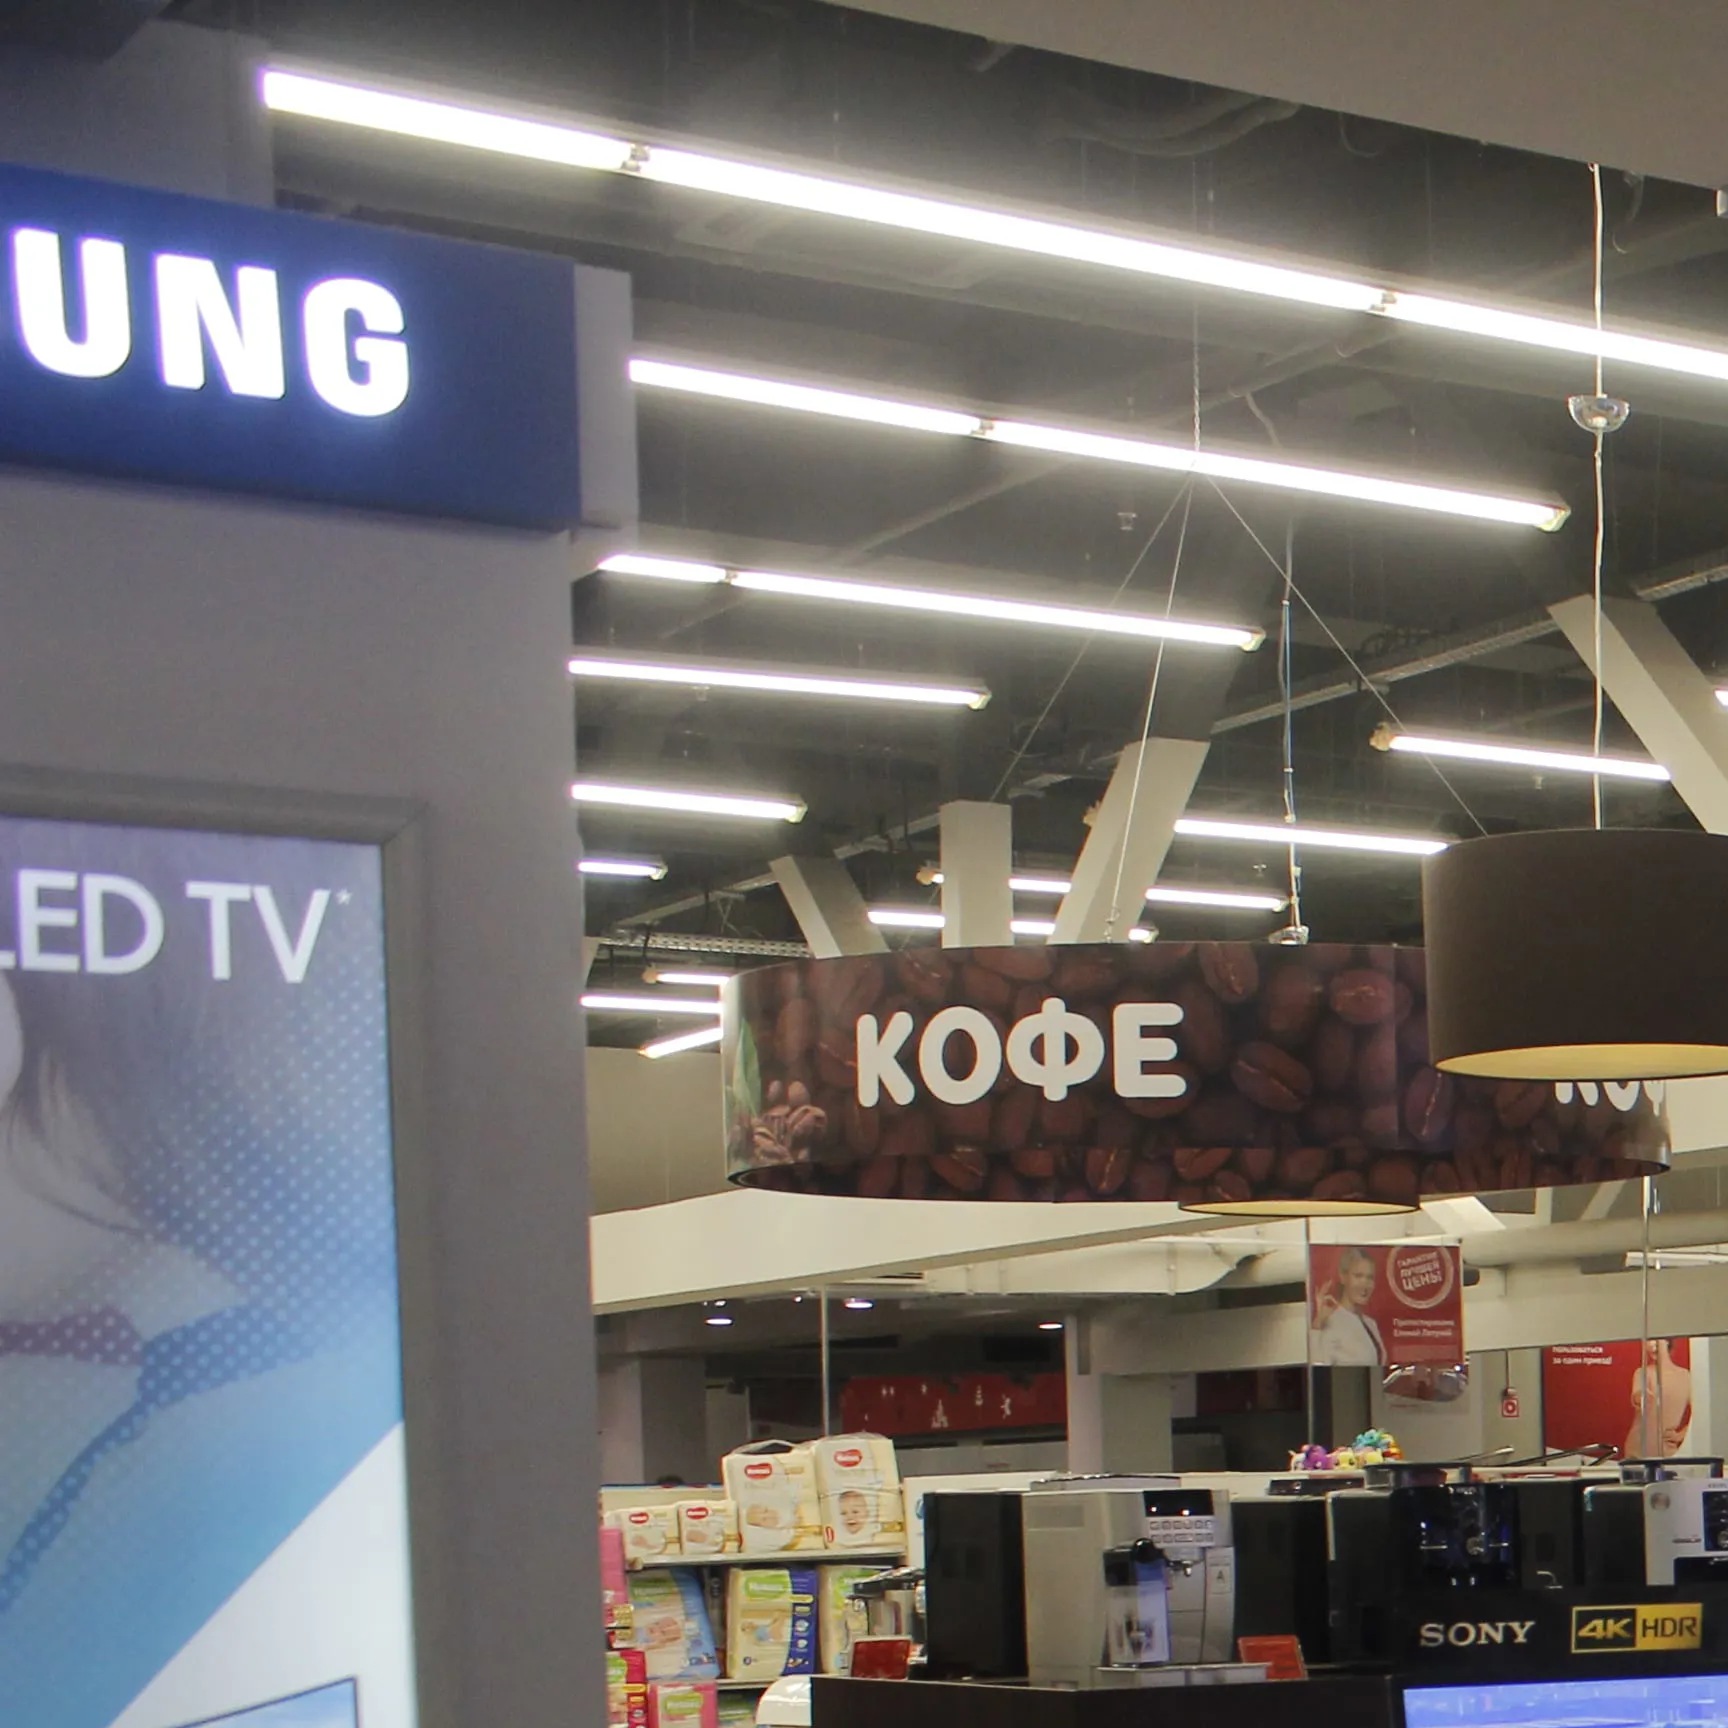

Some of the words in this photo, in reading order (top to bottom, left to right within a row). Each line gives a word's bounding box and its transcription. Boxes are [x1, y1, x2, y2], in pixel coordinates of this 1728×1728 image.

[13, 226, 410, 418] UNG
[0, 868, 165, 975] ED
[856, 997, 1187, 1109] КОФЕ
[1420, 1619, 1537, 1648] SONY
[1576, 1615, 1635, 1642] 4K
[1641, 1614, 1699, 1640] HDR
